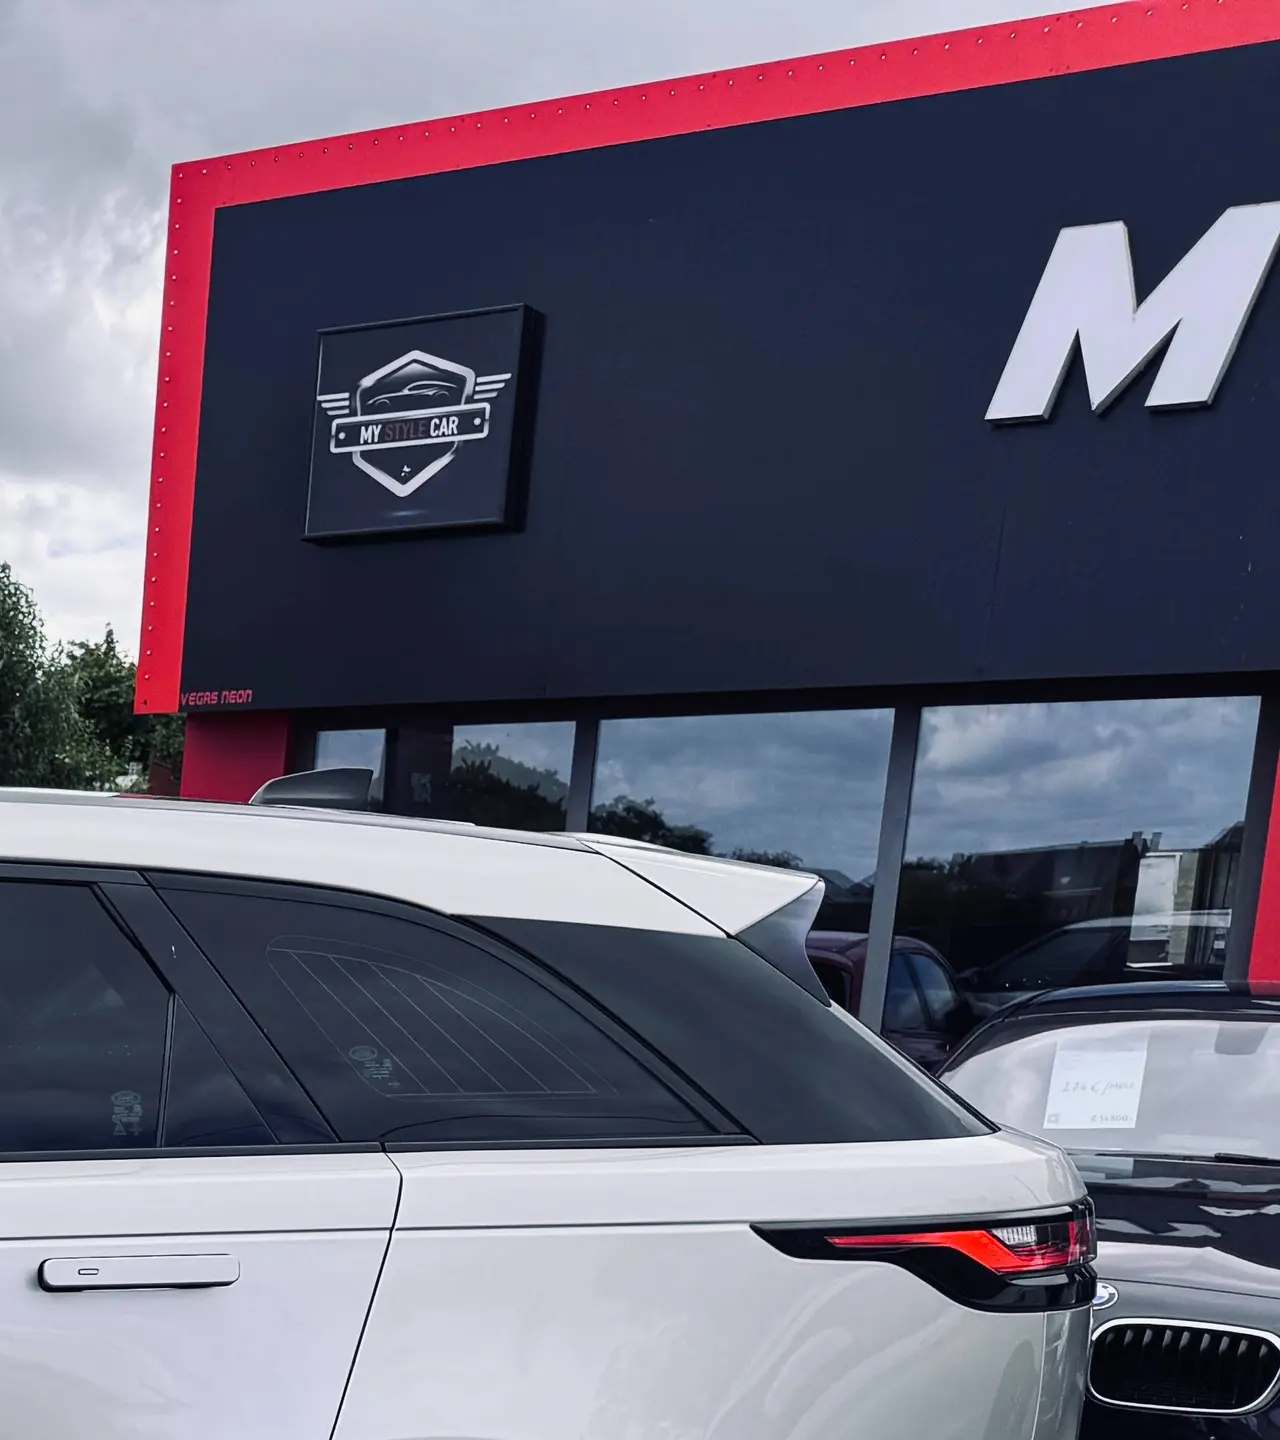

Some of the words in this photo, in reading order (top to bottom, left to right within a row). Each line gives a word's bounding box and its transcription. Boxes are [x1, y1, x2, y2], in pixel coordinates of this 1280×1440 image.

[359, 424, 382, 444] MY
[384, 419, 428, 442] STYLE
[430, 416, 458, 437] CAR
[181, 691, 218, 706] VEGAS
